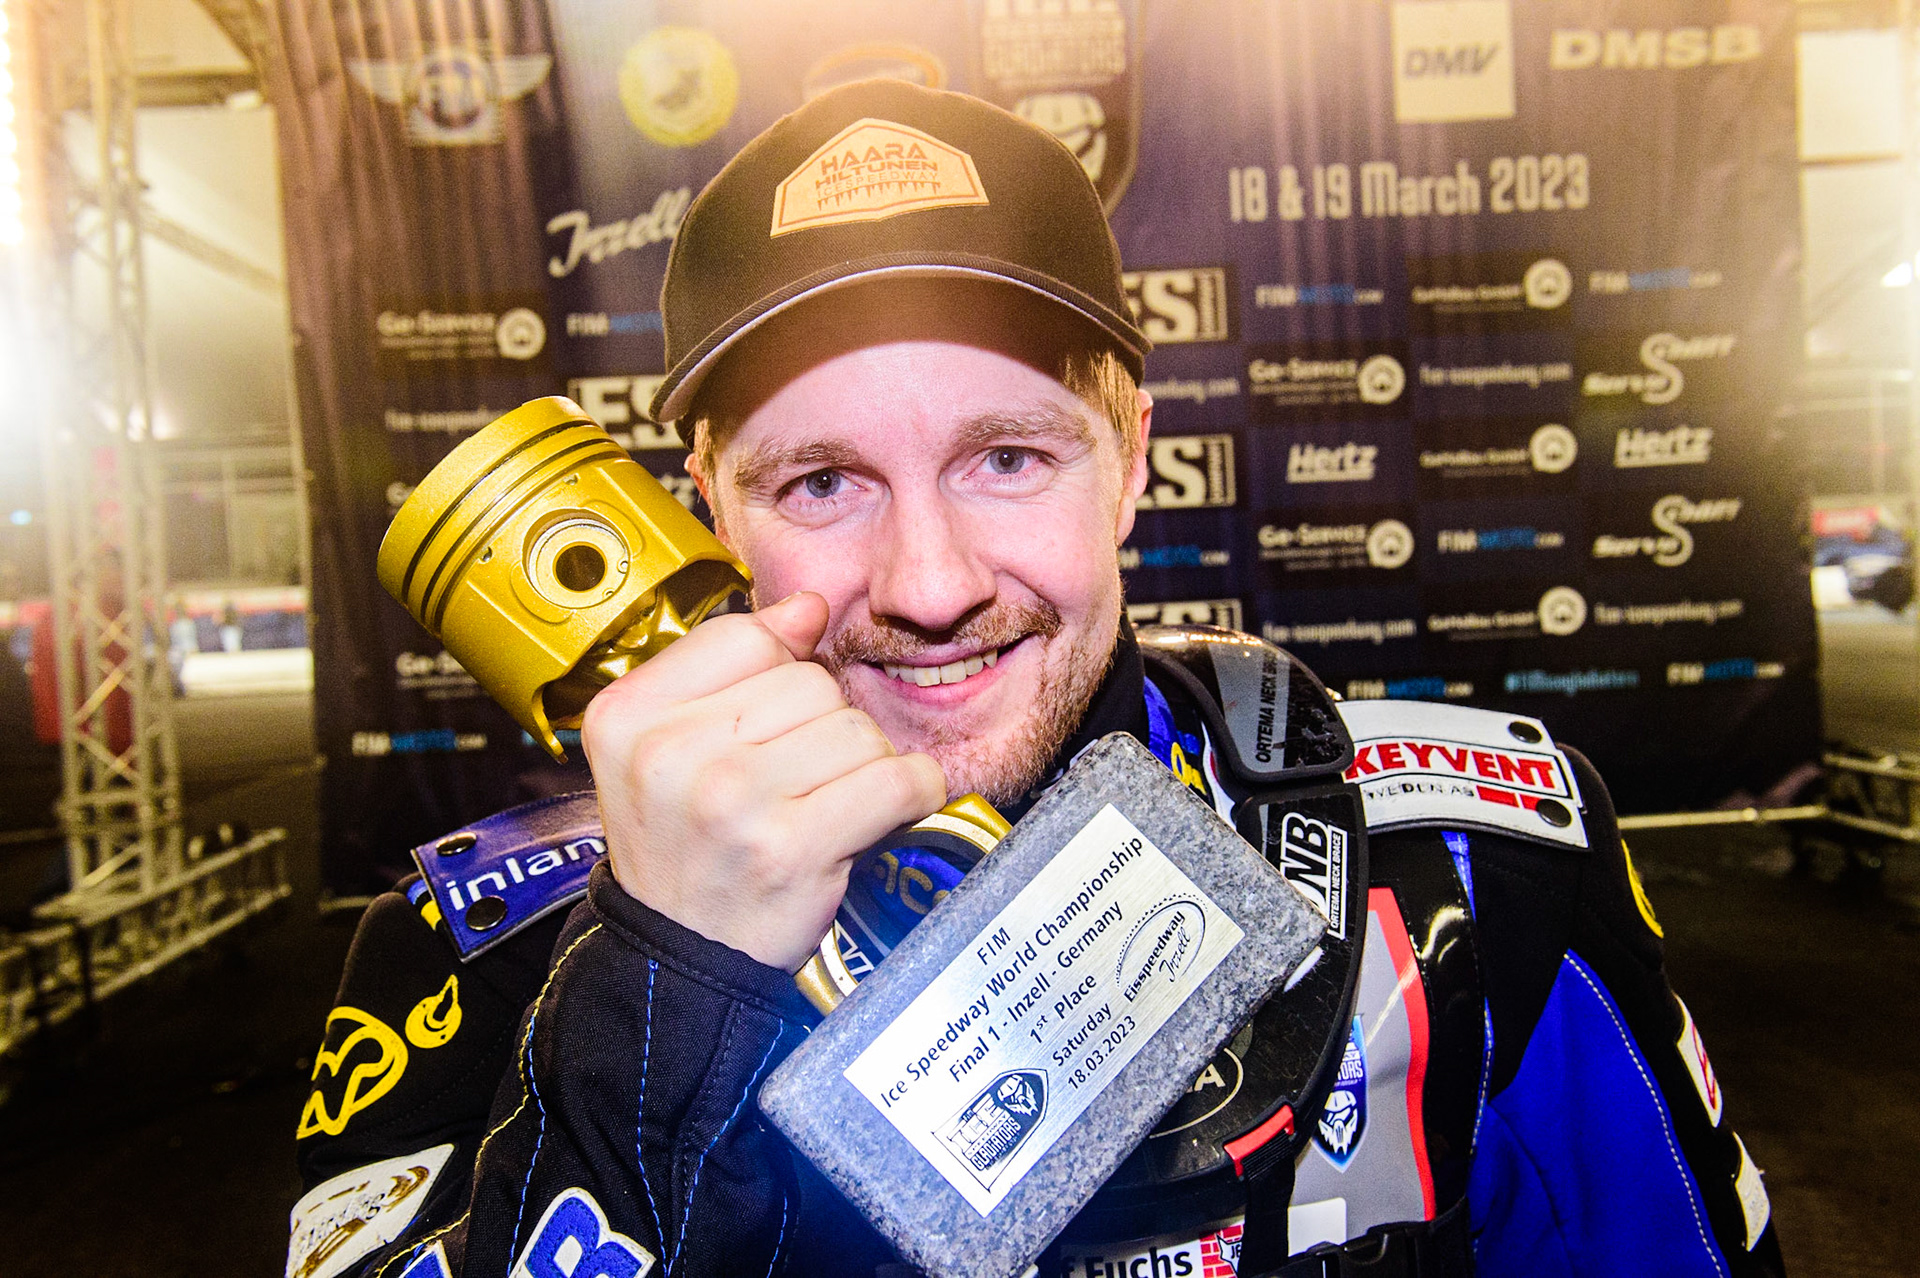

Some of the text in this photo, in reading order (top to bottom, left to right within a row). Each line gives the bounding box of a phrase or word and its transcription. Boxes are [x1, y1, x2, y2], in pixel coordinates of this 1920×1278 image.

[1402, 43, 1502, 79] DMV
[1550, 26, 1763, 70] DMSB
[815, 160, 938, 192] HILTUNEN
[818, 171, 938, 199] ICESPEEDWAY
[821, 142, 928, 176] HAARA
[1228, 154, 1590, 222] 18 & 19 March 2023
[1287, 443, 1379, 482] Hertz
[1615, 425, 1713, 467] Hertz
[1260, 674, 1277, 706] NECK
[1255, 707, 1275, 764] ORTEMA
[1344, 742, 1556, 790] KEYVENT
[1280, 812, 1330, 920] NB
[1330, 832, 1342, 928] ORTEMA NECK BRACE
[881, 1079, 909, 1108] Ice
[906, 996, 991, 1082] Speedway
[986, 941, 1038, 998] World
[1035, 836, 1143, 948] Championship
[976, 926, 1012, 966] FIM
[1124, 910, 1186, 1003] Eisspeedway
[1158, 926, 1192, 983] Inzell
[949, 1036, 990, 1083] Final
[988, 1025, 1001, 1042] 1
[1007, 971, 1052, 1022] Inzell
[1057, 901, 1124, 969] Germany
[1029, 973, 1098, 1044] 1st Place
[1052, 1002, 1113, 1067] Saturday
[1067, 1014, 1137, 1090] 18.03.2023
[970, 1116, 1022, 1171] GLADIATORS
[1085, 1246, 1194, 1278] Fuchs
